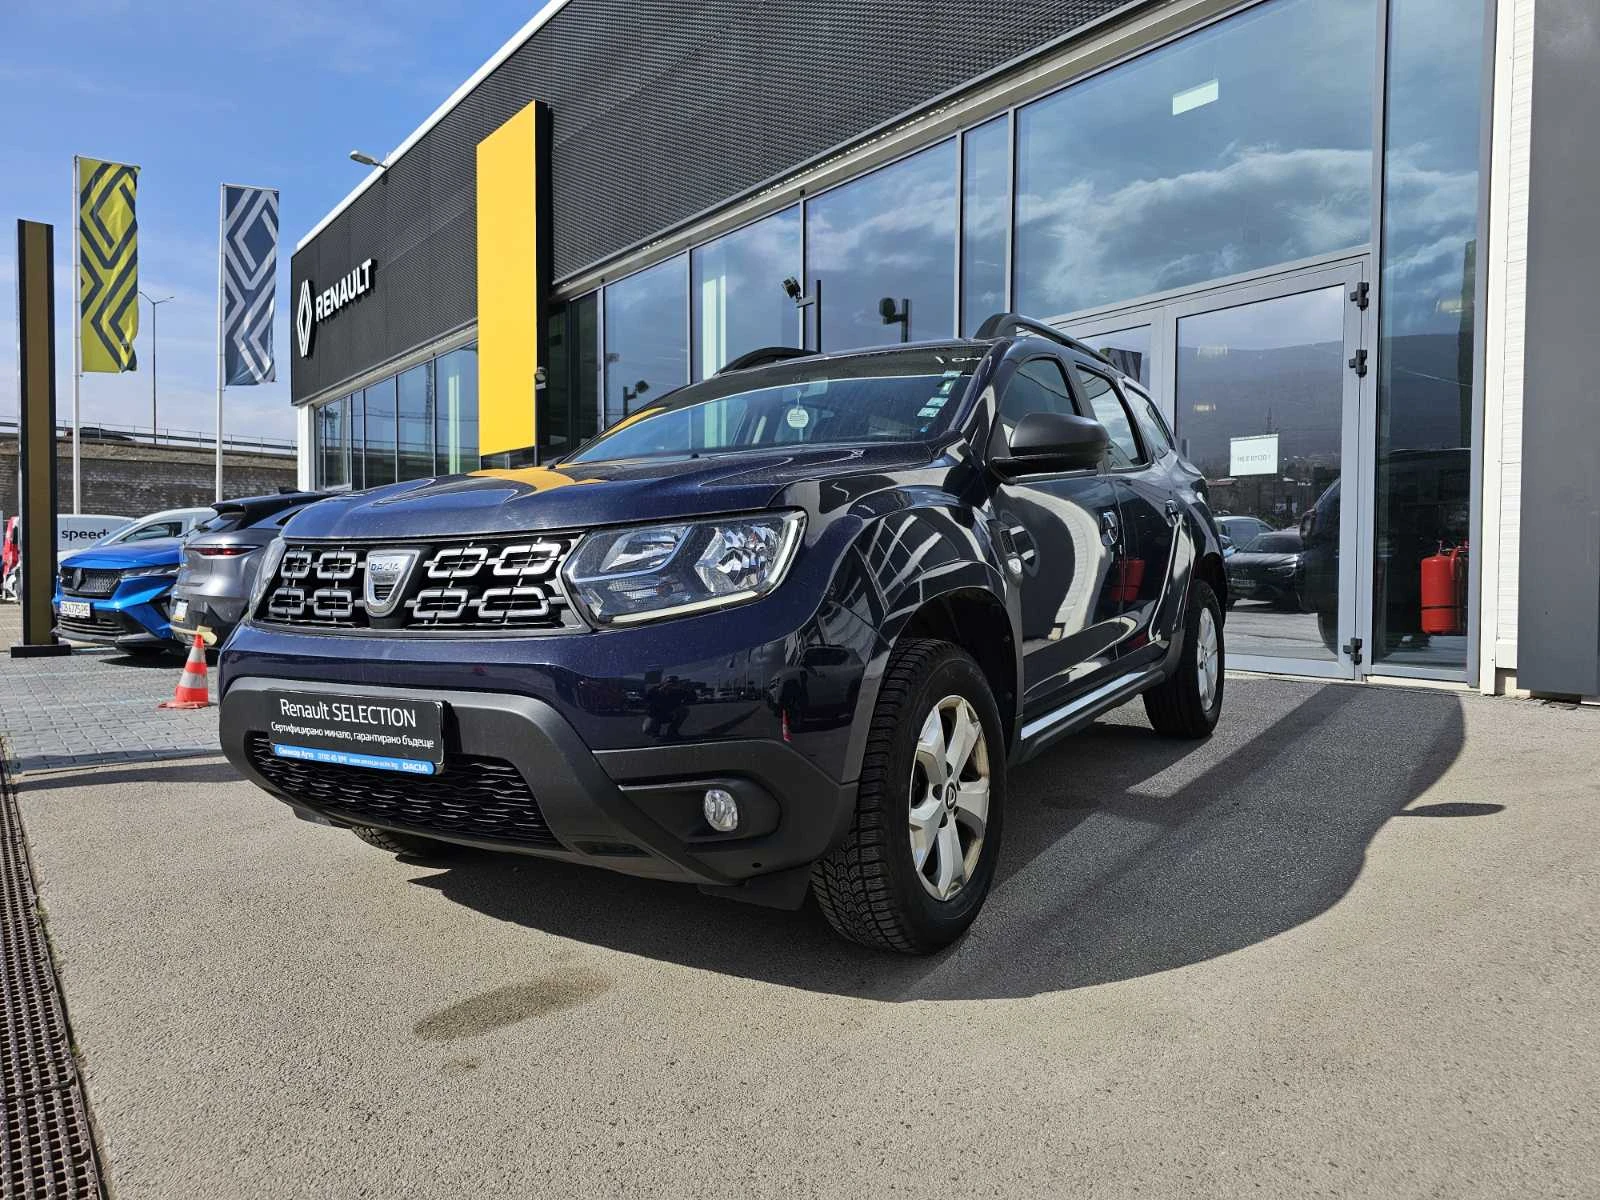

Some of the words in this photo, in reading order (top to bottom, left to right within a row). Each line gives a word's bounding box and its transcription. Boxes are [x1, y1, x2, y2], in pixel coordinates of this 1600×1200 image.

[316, 258, 372, 322] RENAULT
[280, 698, 330, 720] Renault
[332, 703, 416, 727] SELECTION
[271, 721, 324, 737] Сертифицирано
[324, 729, 353, 741] минало,
[353, 732, 401, 745] гарантирано
[402, 734, 435, 749] бъдеще
